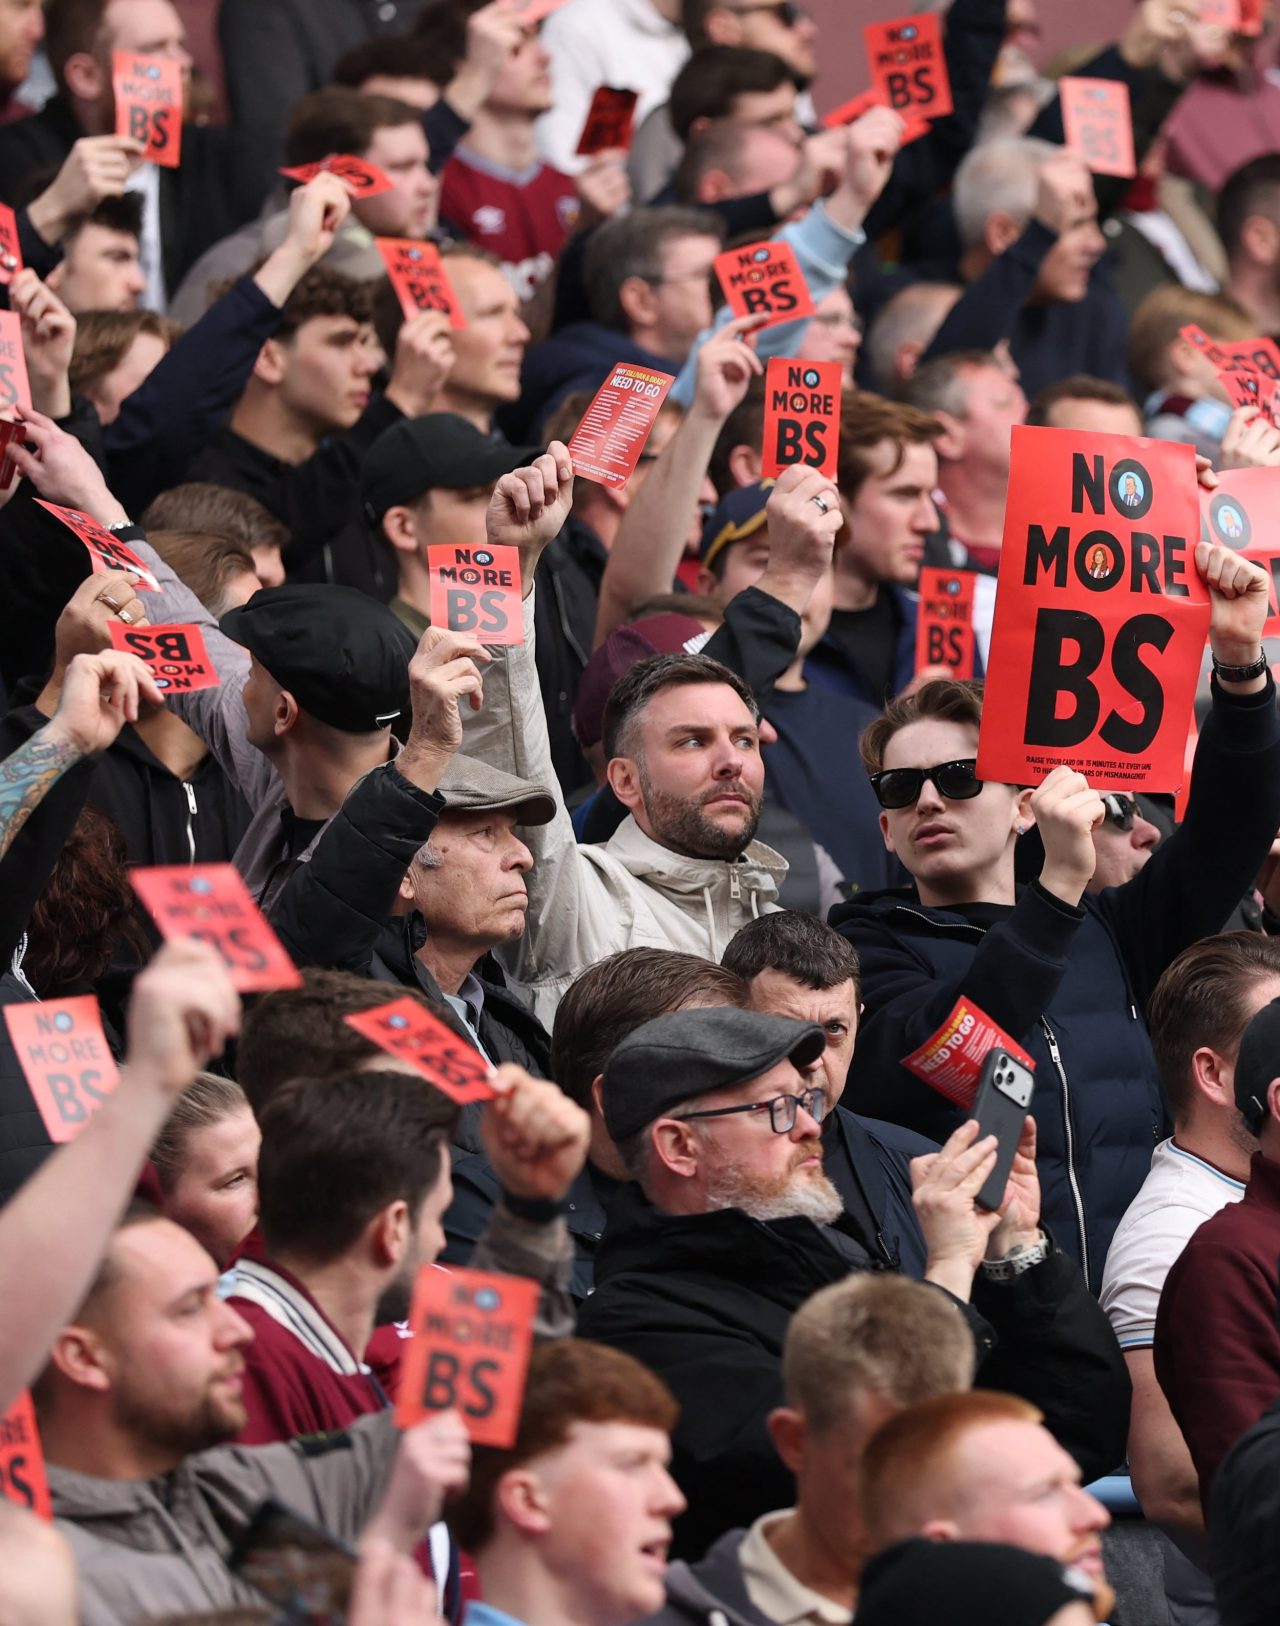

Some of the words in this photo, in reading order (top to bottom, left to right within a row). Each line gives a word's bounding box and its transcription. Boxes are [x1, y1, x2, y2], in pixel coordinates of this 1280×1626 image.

[886, 24, 918, 41] NO
[877, 43, 932, 65] MORE
[133, 60, 161, 79] NO
[887, 67, 935, 109] BS
[130, 105, 169, 148] BS
[738, 248, 771, 267] NO
[729, 261, 790, 287] MORE
[742, 281, 798, 314] BS
[610, 375, 633, 389] NEED
[632, 380, 645, 392] TO
[645, 384, 660, 398] GO
[788, 367, 820, 389] NO
[772, 390, 833, 415] MORE
[776, 418, 827, 468] BS
[1072, 452, 1153, 520] NO
[1200, 493, 1252, 550] O
[455, 548, 494, 566] NO
[1023, 524, 1190, 597] MORE
[439, 566, 512, 586] MORE
[936, 578, 961, 596] NO
[447, 589, 508, 632] BS
[124, 632, 192, 661] BS
[928, 624, 963, 667] BS
[151, 664, 205, 675] MO
[1023, 607, 1175, 755] BS
[1026, 755, 1044, 764] RAISE
[1046, 757, 1062, 765] YOUR
[1063, 758, 1075, 766] CARD
[1092, 760, 1116, 768] MINUTES
[1126, 762, 1140, 770] EVERY
[1104, 771, 1146, 780] MISMANAGEMENT
[35, 1011, 73, 1034] NO
[27, 1038, 102, 1065] MORE
[920, 1048, 951, 1073] NEED
[945, 1033, 964, 1050] TO
[958, 1014, 976, 1035] GO
[46, 1069, 107, 1123] BS
[454, 1285, 500, 1312] NO
[424, 1312, 513, 1349] MORE
[422, 1352, 501, 1418] BS
